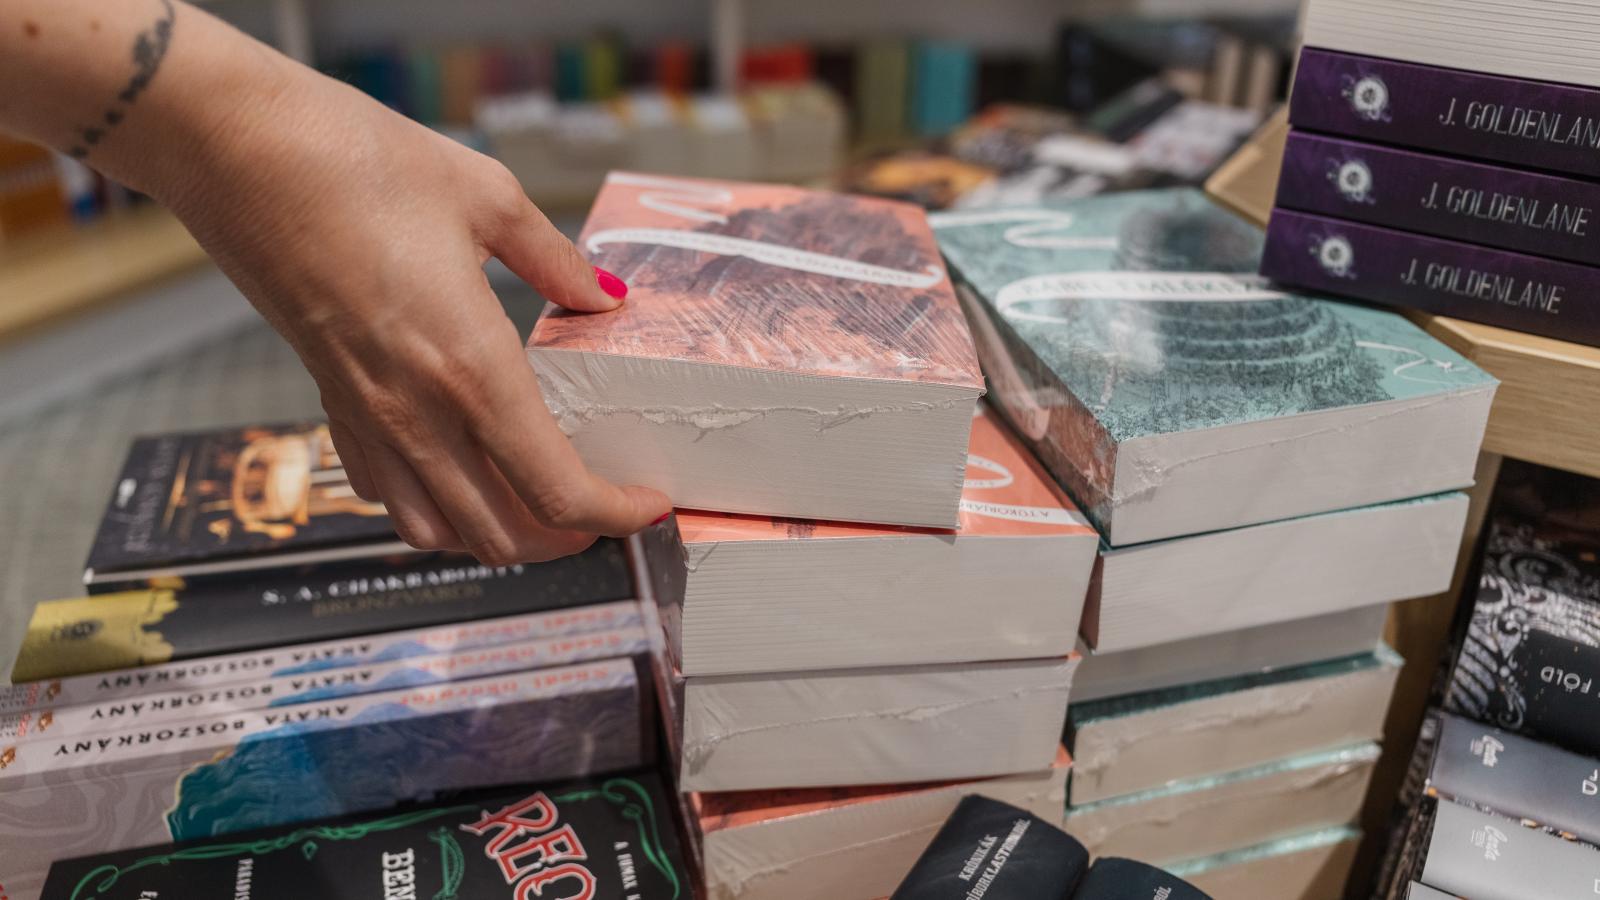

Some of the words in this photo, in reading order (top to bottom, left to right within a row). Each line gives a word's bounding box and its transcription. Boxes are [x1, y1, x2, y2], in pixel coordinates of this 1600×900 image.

[1438, 98, 1456, 127] J.
[1465, 103, 1600, 149] GOLDENLAN
[1420, 182, 1438, 209] J.
[1446, 185, 1593, 237] GOLDENLANE
[1400, 258, 1417, 285] J.
[1424, 262, 1566, 315] GOLDENLANE
[291, 643, 371, 663] AKATA
[291, 670, 372, 692] AKATA
[1540, 665, 1593, 695] FÖLD
[264, 703, 349, 726] AKATA
[54, 719, 246, 757] BOSZORKÁNY
